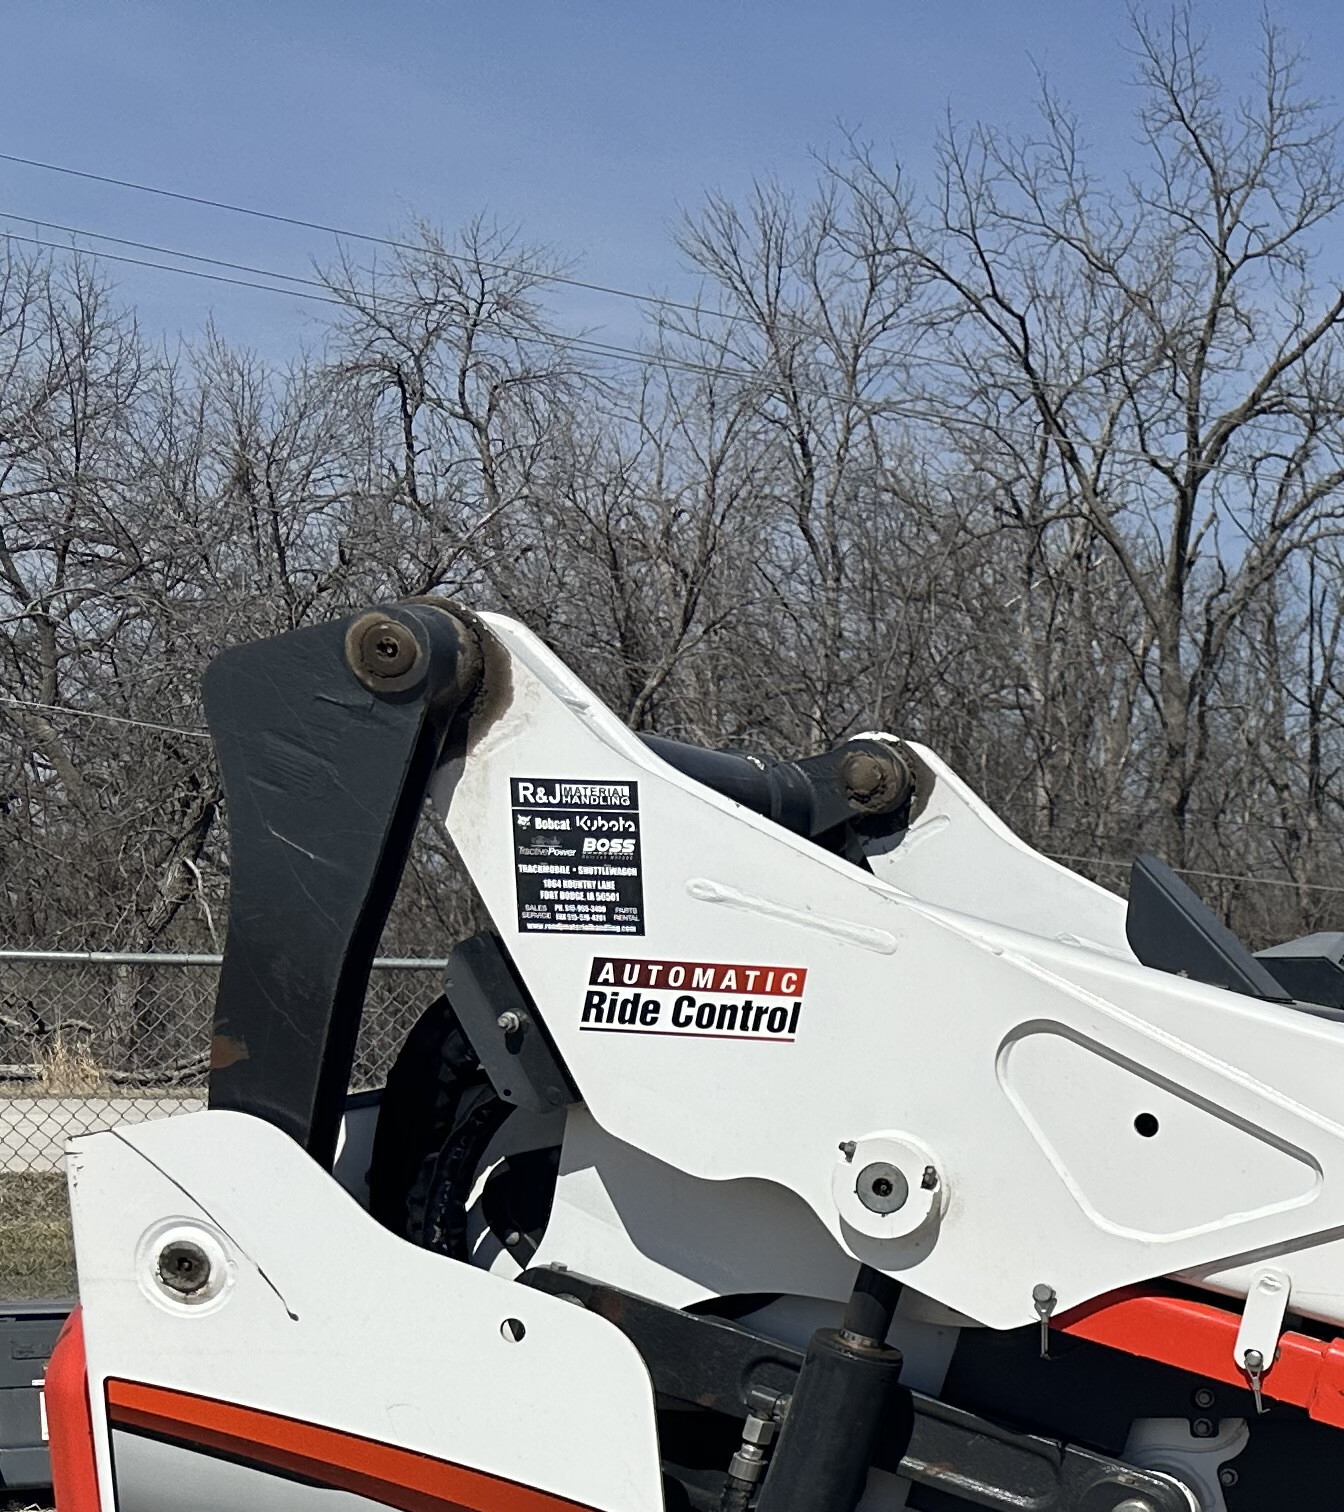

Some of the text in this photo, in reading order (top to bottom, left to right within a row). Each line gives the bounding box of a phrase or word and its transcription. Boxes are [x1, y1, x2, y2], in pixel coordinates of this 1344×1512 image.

[518, 782, 561, 804] R&J
[563, 785, 629, 797] MATERIAL
[562, 795, 631, 806] HANDLING
[534, 817, 570, 831] Bobcat
[575, 815, 636, 832] Kubota
[583, 837, 636, 853] BOSS
[597, 962, 798, 994] AUTOMATIC
[581, 990, 803, 1034] Ride Control
